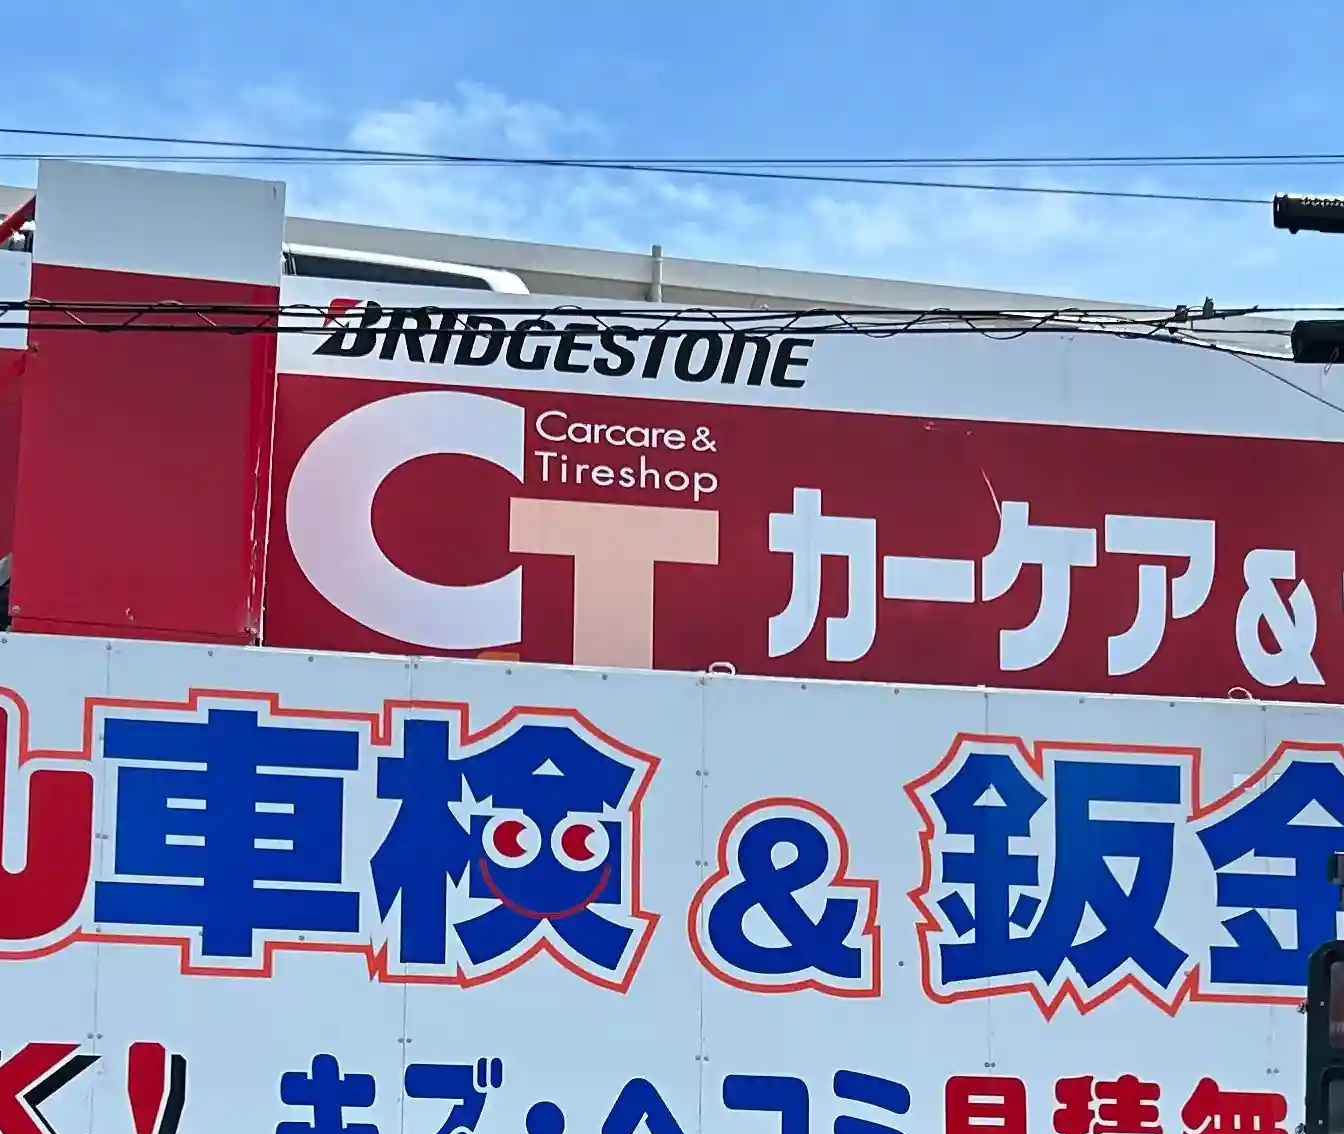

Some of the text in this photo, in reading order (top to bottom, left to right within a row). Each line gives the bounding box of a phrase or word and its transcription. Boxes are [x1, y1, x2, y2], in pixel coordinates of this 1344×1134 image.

[313, 298, 814, 388] BRIDGESTONE
[535, 410, 718, 453] Carcare &
[535, 451, 718, 501] Tireshop
